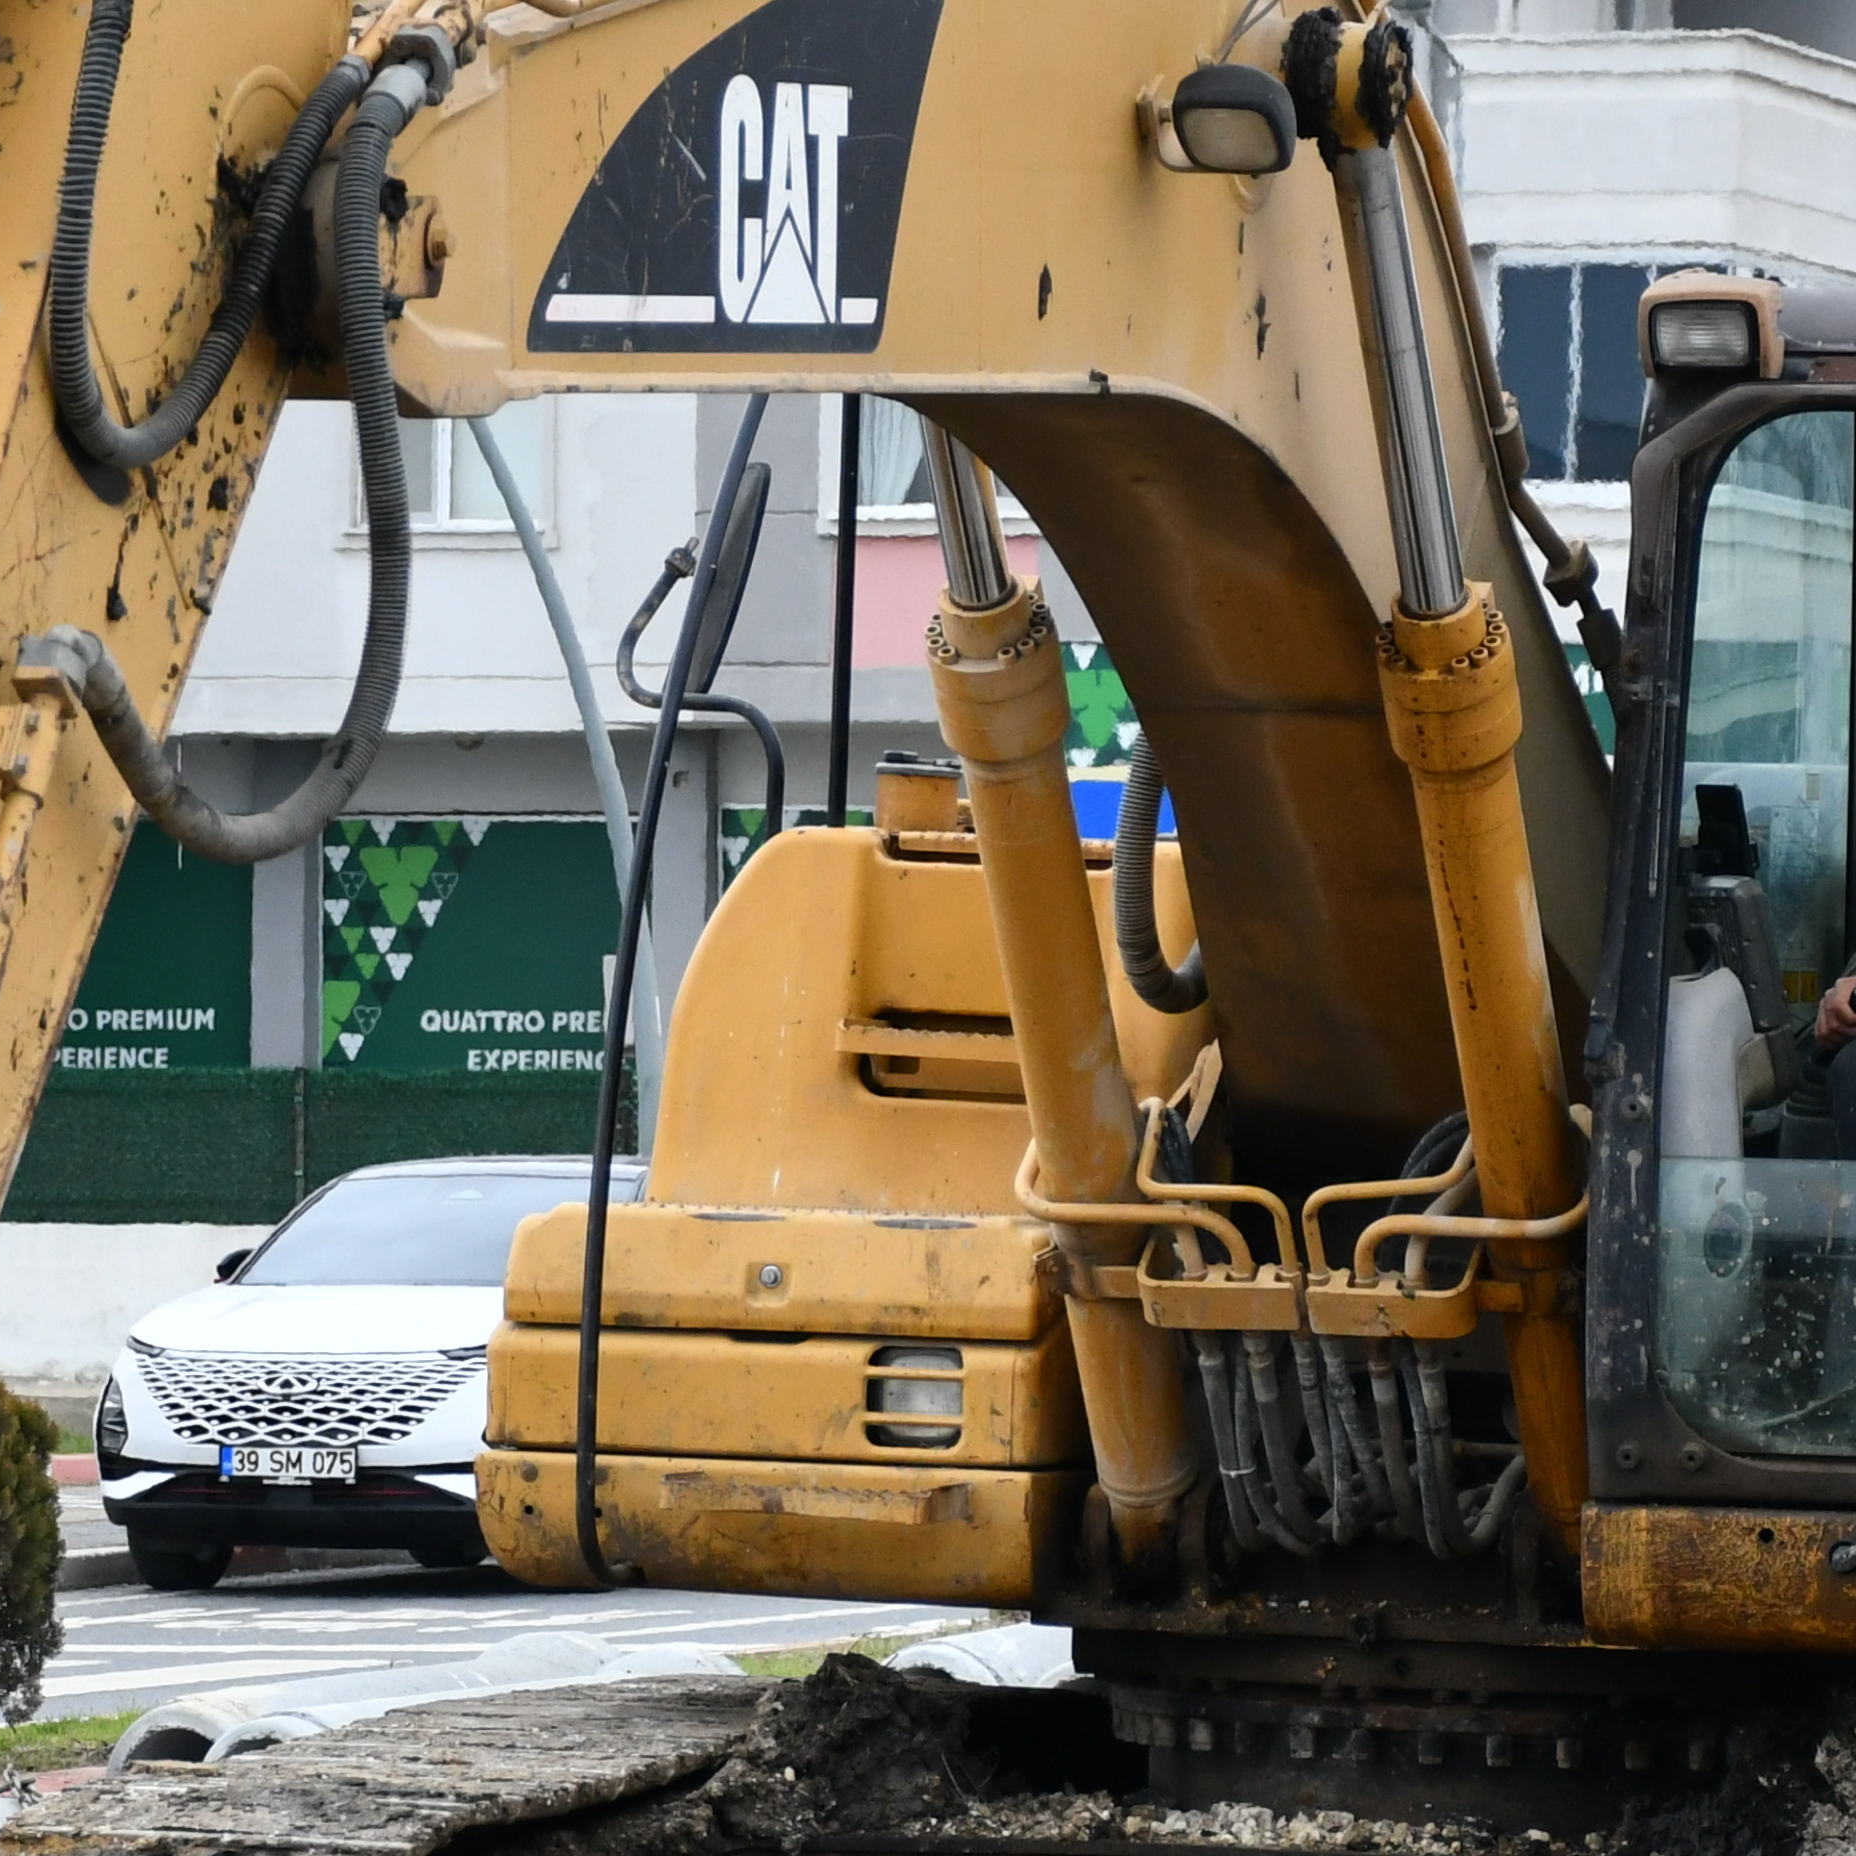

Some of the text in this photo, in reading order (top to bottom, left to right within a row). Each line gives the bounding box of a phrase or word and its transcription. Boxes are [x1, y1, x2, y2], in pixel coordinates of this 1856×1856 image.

[719, 74, 849, 324] CAT
[95, 1007, 215, 1031] PREMIUM
[420, 1009, 604, 1033] QUATTRO PRE
[234, 1450, 353, 1475] 39 SM 075
